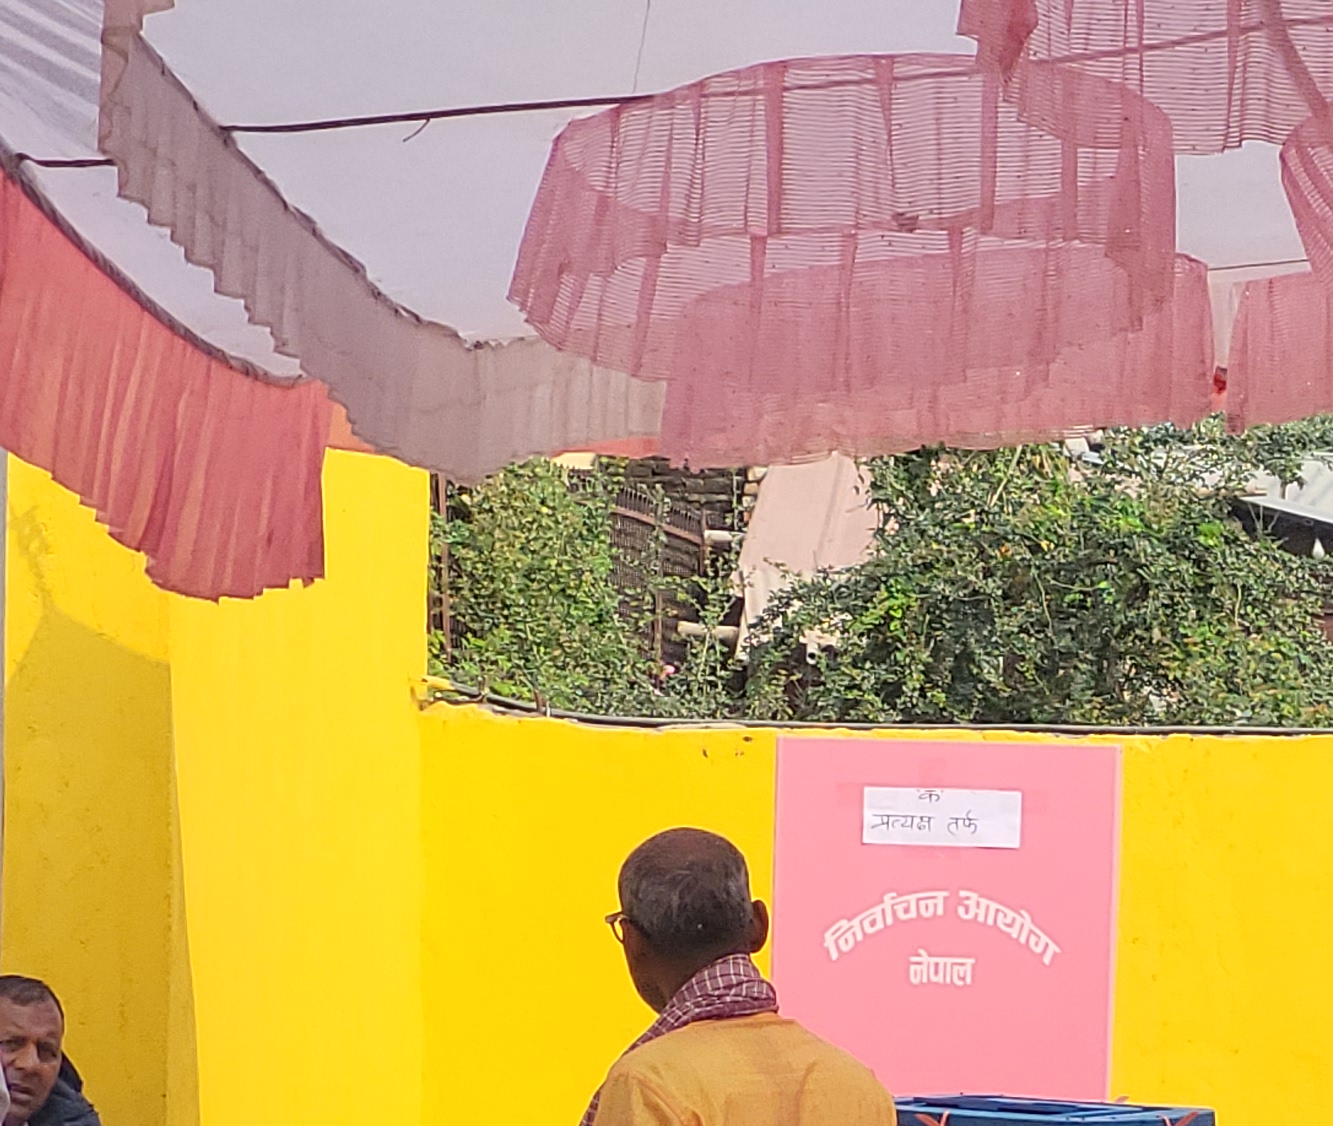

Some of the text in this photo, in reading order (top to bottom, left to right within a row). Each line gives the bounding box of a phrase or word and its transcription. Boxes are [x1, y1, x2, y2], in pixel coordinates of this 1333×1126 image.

[871, 809, 979, 836] प्रत्यक्ष तर्फ
[823, 890, 1061, 965] निर्वाचन आयोग
[909, 949, 975, 986] नेपाल
